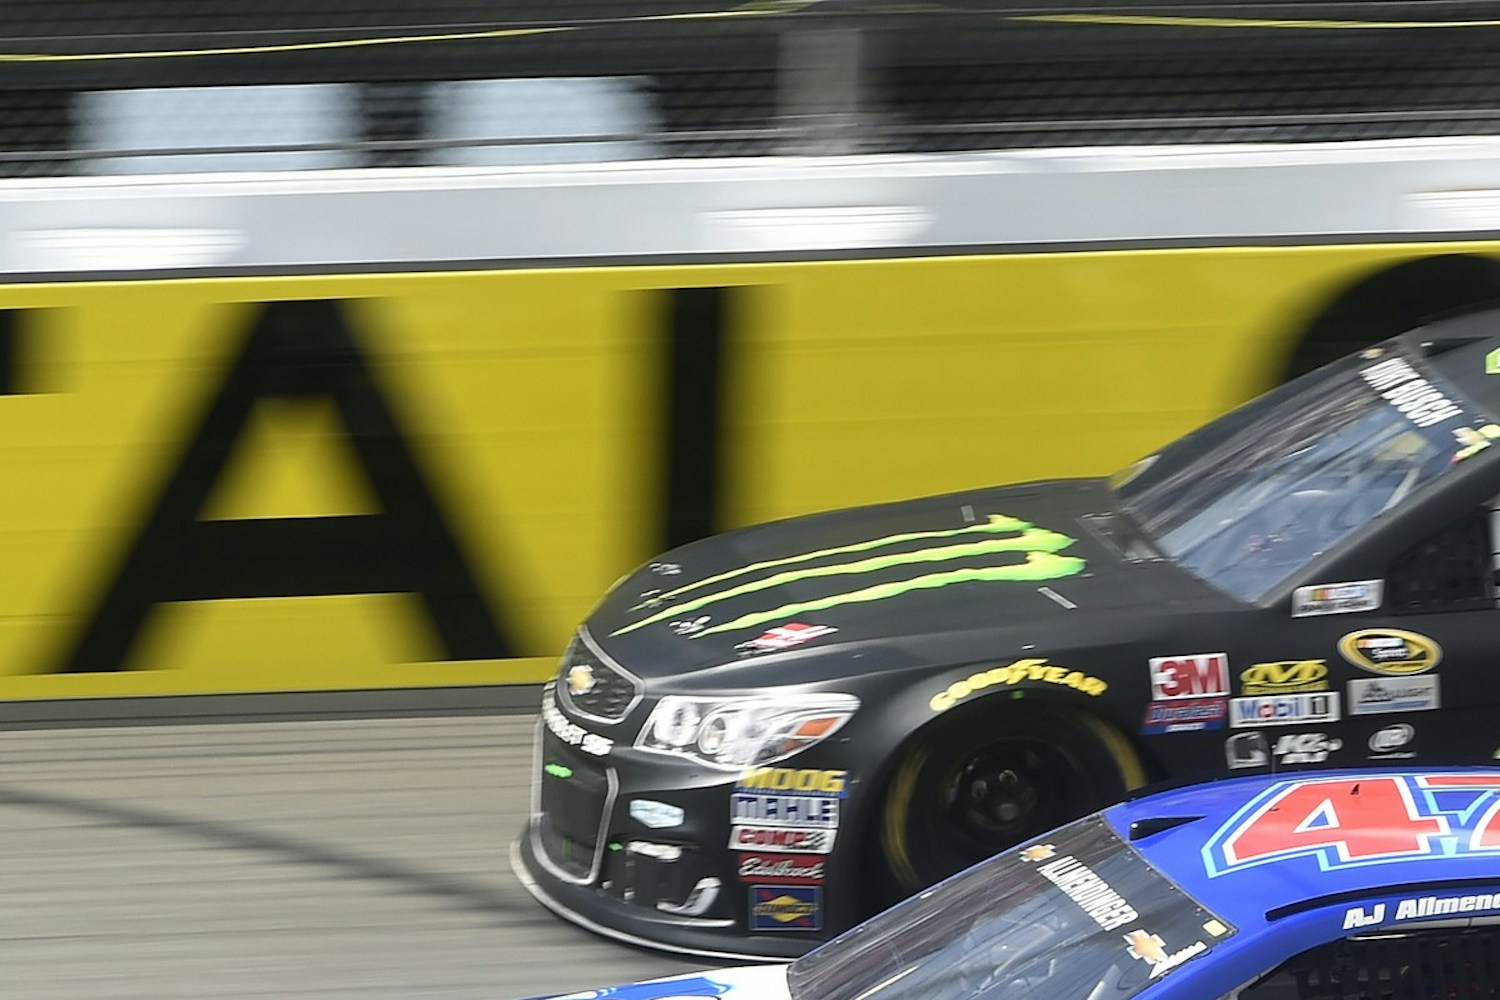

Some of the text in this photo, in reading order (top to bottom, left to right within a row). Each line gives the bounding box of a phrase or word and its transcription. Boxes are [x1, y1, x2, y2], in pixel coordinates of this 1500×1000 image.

[1381, 379, 1464, 427] BUSCH
[929, 657, 1108, 713] GOODYEAR
[1154, 657, 1224, 696] 3M
[737, 767, 847, 792] MOOG
[1036, 855, 1139, 931] ALLMENDINGER
[1343, 904, 1386, 929] AJ
